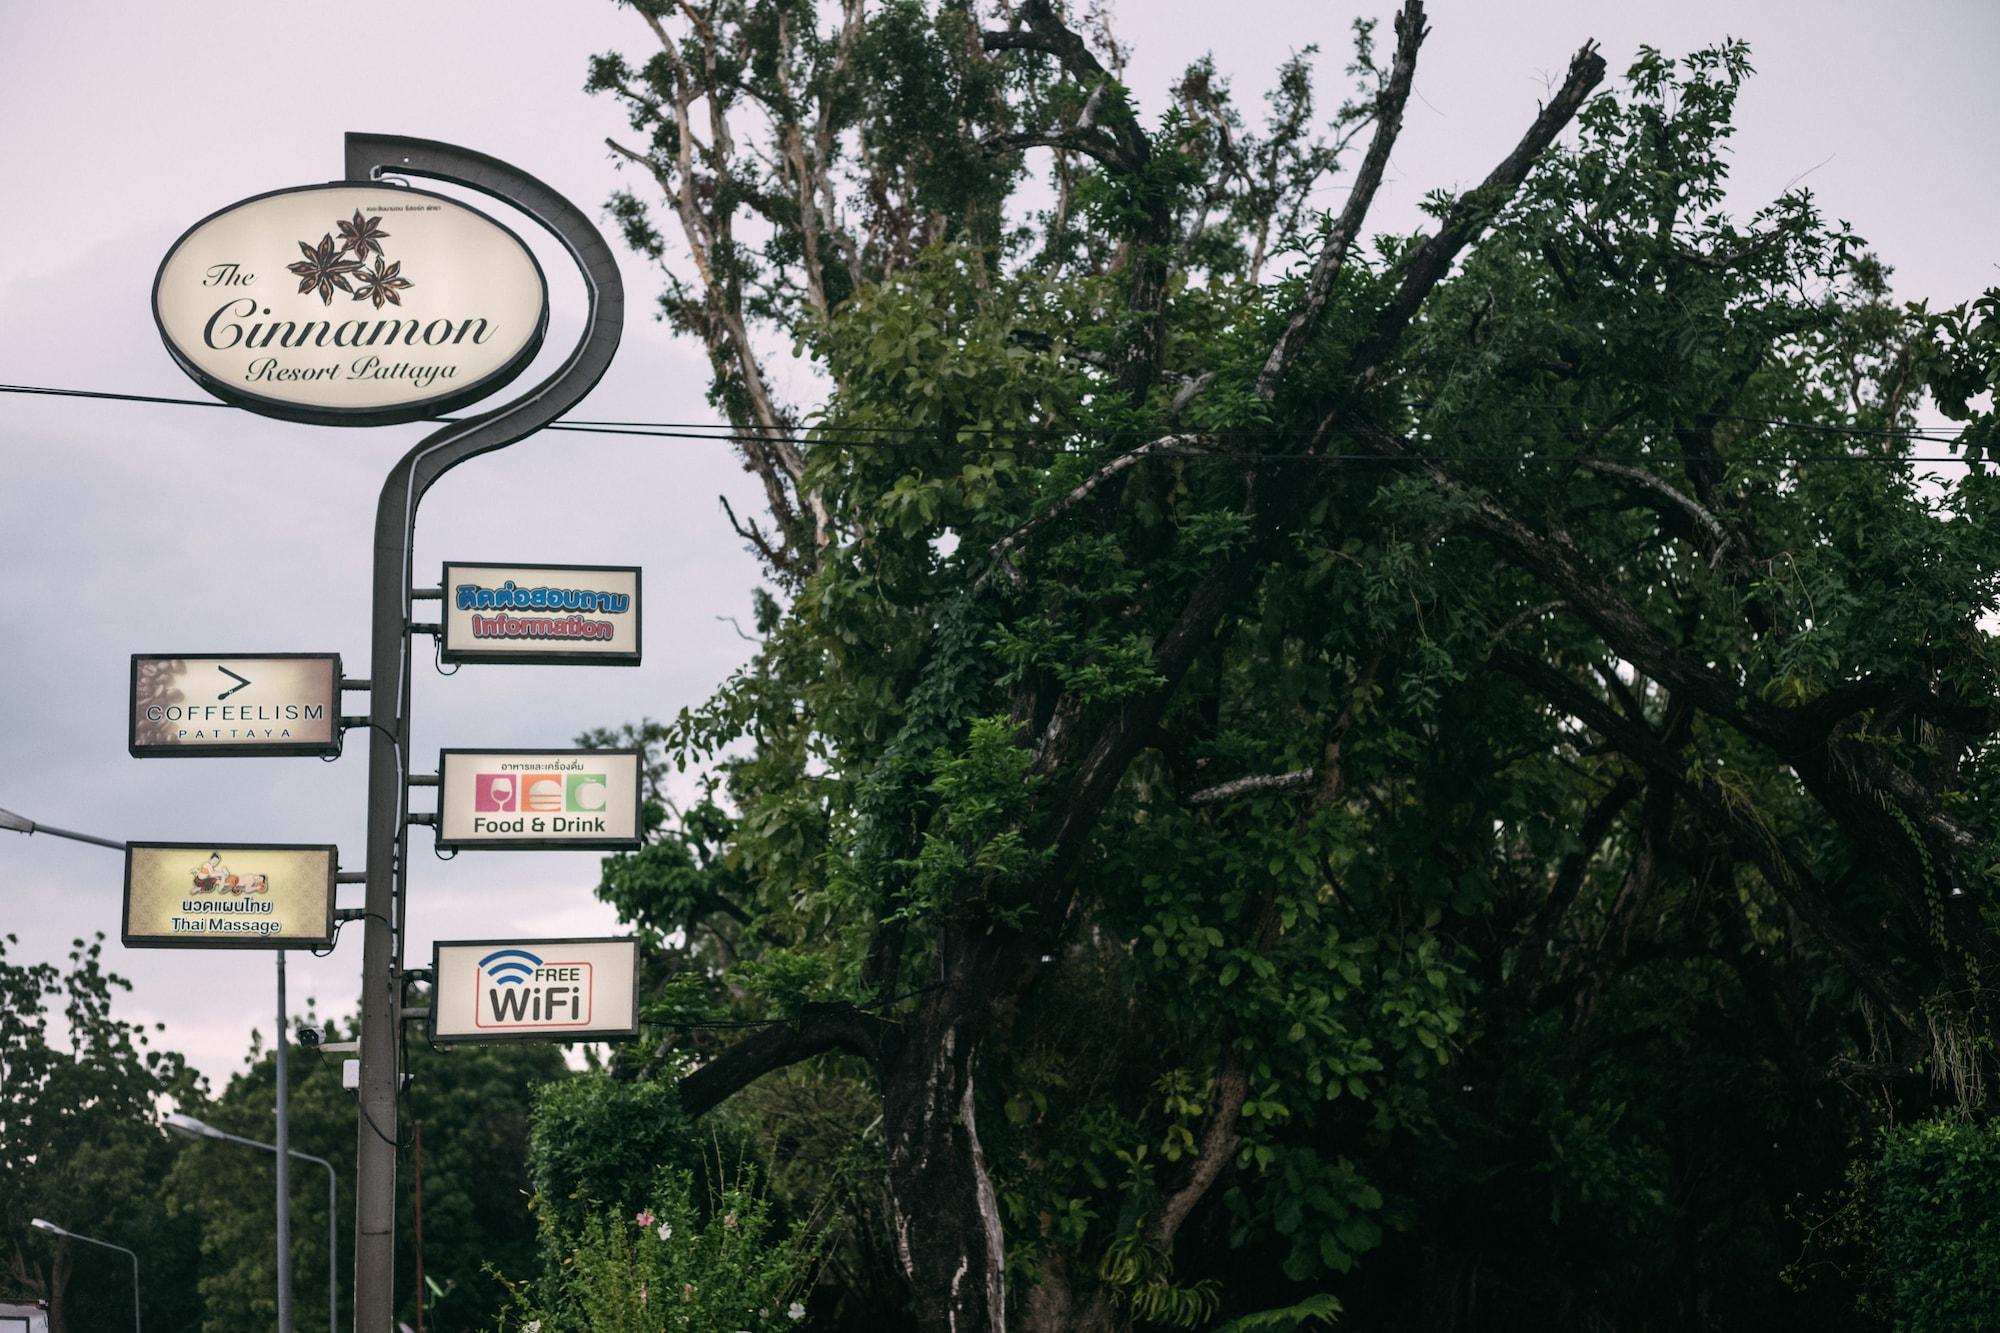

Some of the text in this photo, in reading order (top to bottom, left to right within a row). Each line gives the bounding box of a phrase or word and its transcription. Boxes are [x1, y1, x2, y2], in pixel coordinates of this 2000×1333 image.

[202, 264, 256, 287] The
[204, 299, 498, 350] Cinnamon
[245, 355, 461, 388] Resort Pattaya
[457, 580, 629, 613] ติดต่อสอบถาม
[472, 614, 614, 641] Information
[147, 705, 323, 721] COFFEELISM
[179, 729, 290, 738] PATTAYA
[501, 759, 584, 771] อาหารและเครื่องดื่ม
[474, 817, 605, 833] Food & Drink
[182, 897, 272, 912] นวดแผนไทย
[172, 917, 281, 934] Thai Massage
[535, 968, 580, 981] FREE
[489, 987, 580, 1022] WiFi
